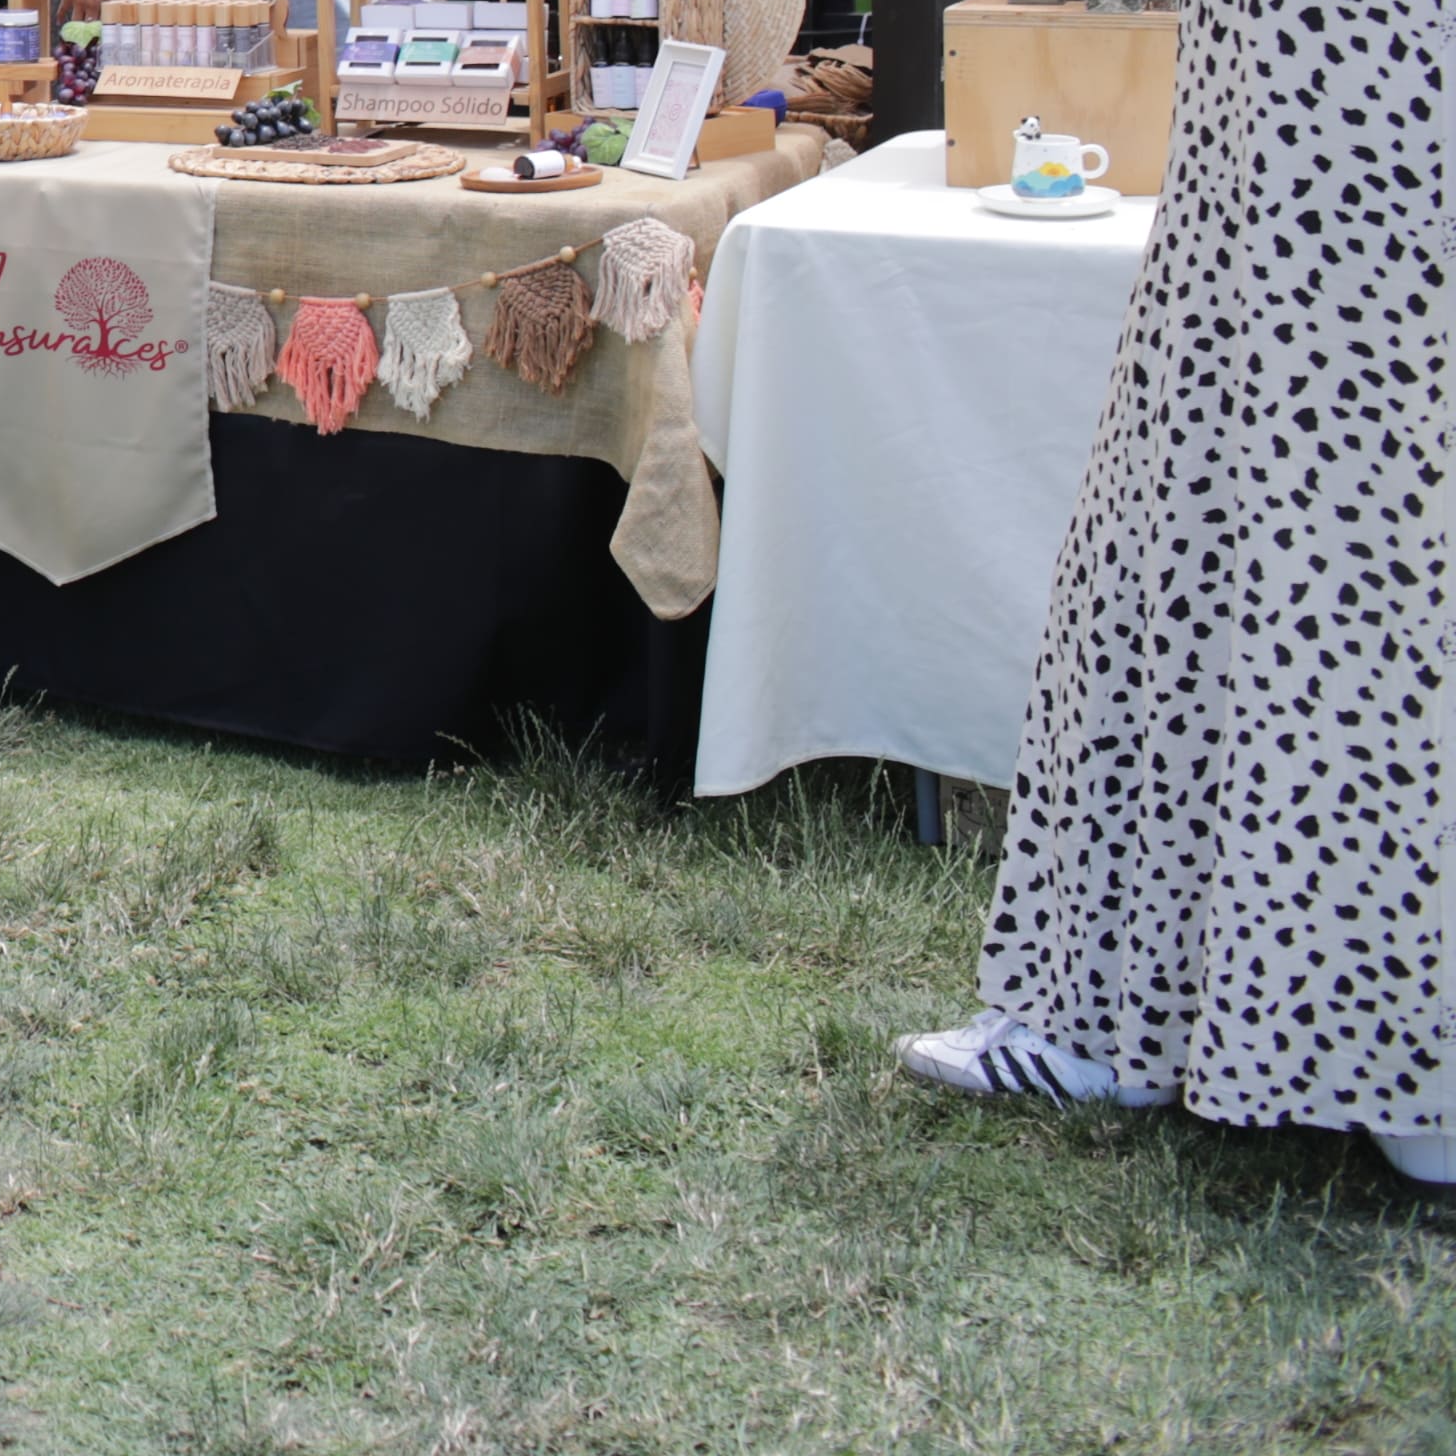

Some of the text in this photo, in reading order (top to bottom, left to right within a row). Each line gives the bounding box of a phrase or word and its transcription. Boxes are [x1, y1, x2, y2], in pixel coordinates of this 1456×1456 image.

[104, 72, 232, 92] Aromaterapia
[342, 93, 503, 116] Shampoo Sólido
